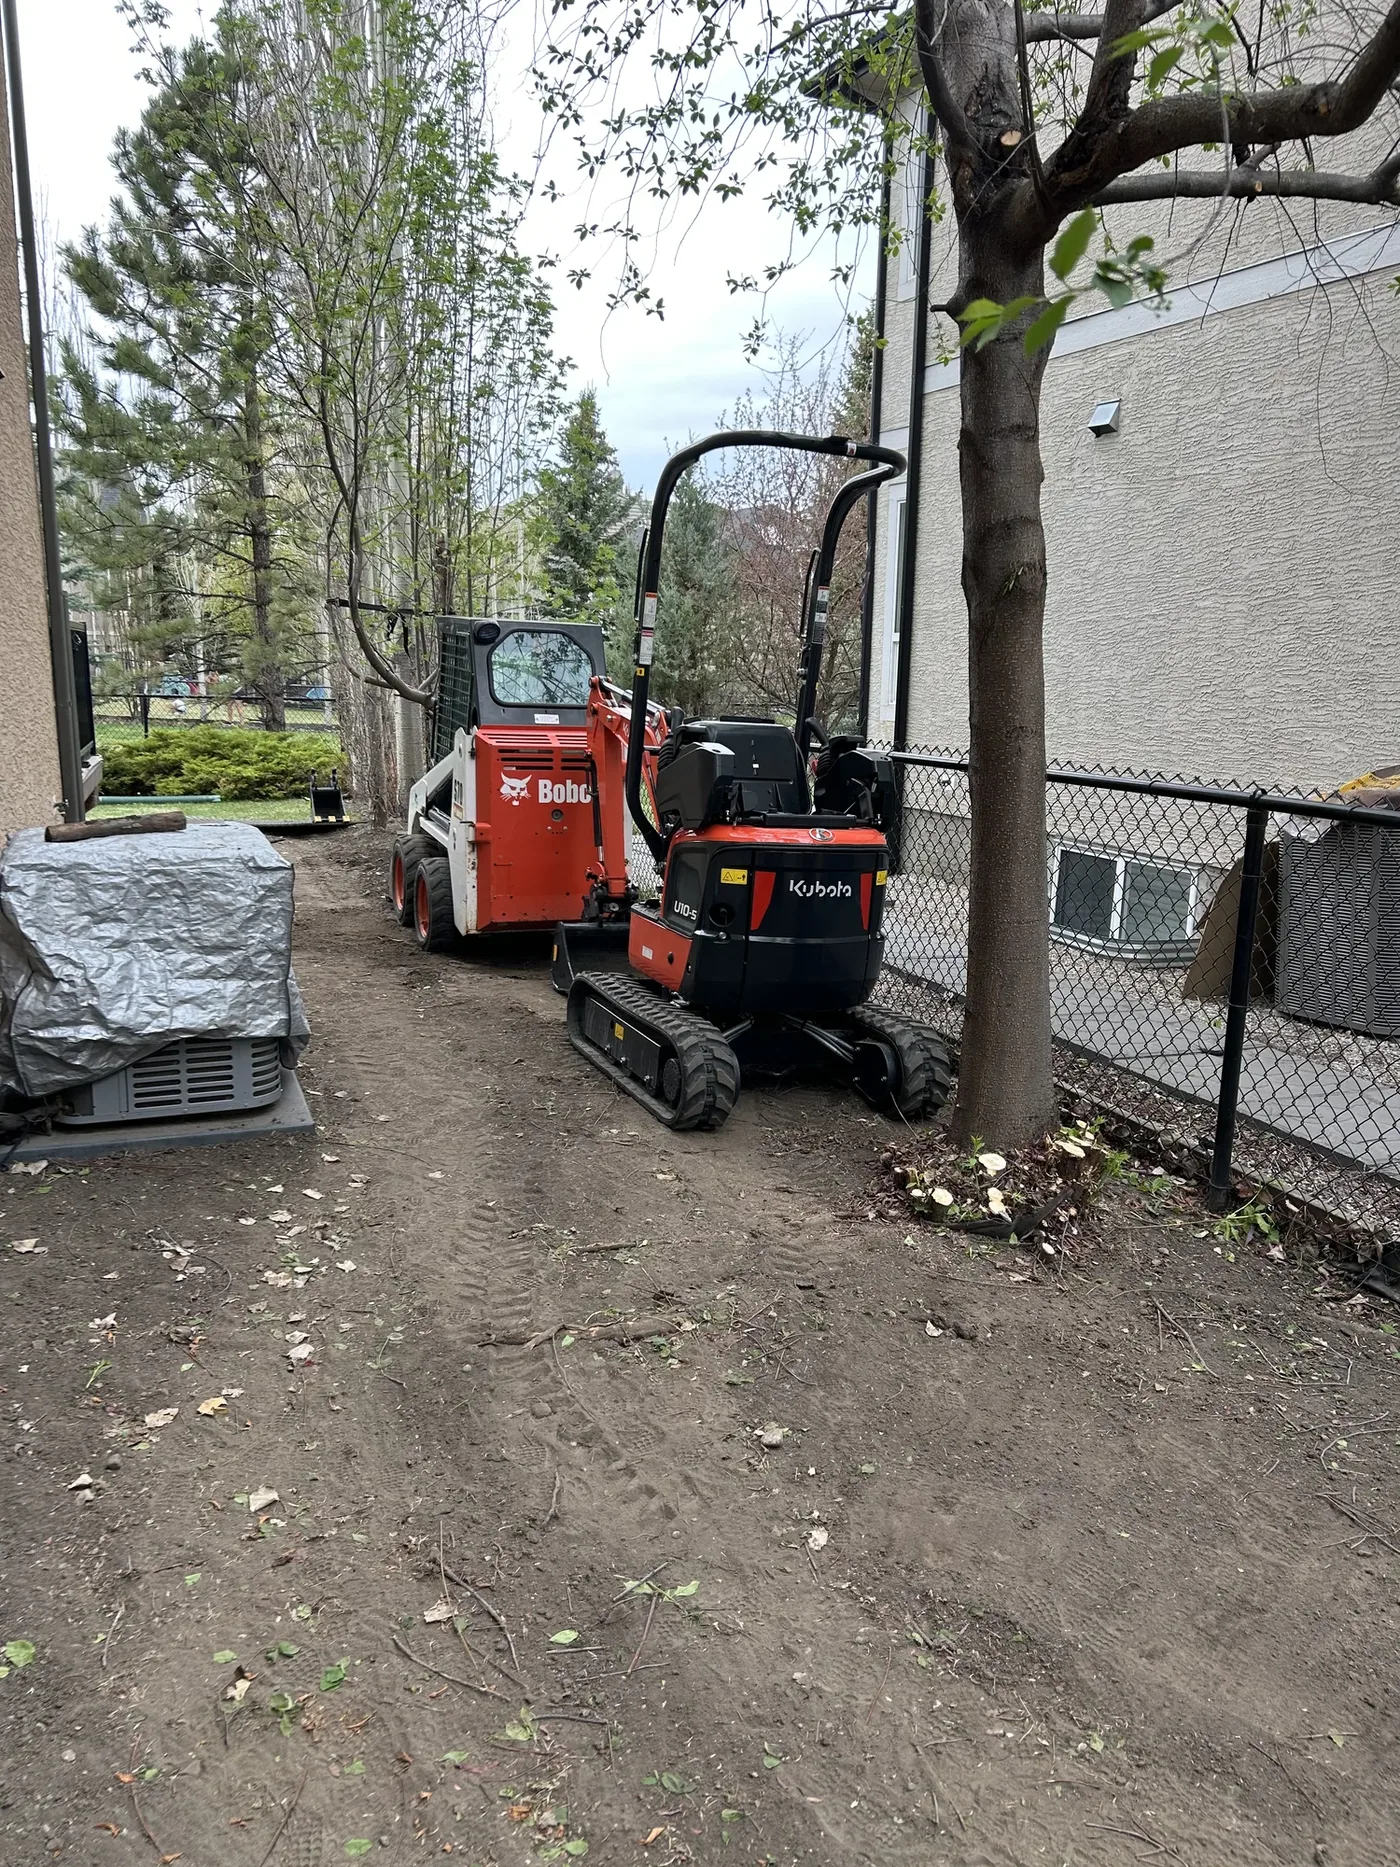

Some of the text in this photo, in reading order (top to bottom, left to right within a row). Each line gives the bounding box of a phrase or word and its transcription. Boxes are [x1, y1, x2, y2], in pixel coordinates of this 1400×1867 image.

[538, 779, 592, 804] Bobc
[789, 879, 852, 897] Kubota
[674, 900, 697, 920] U10-5
